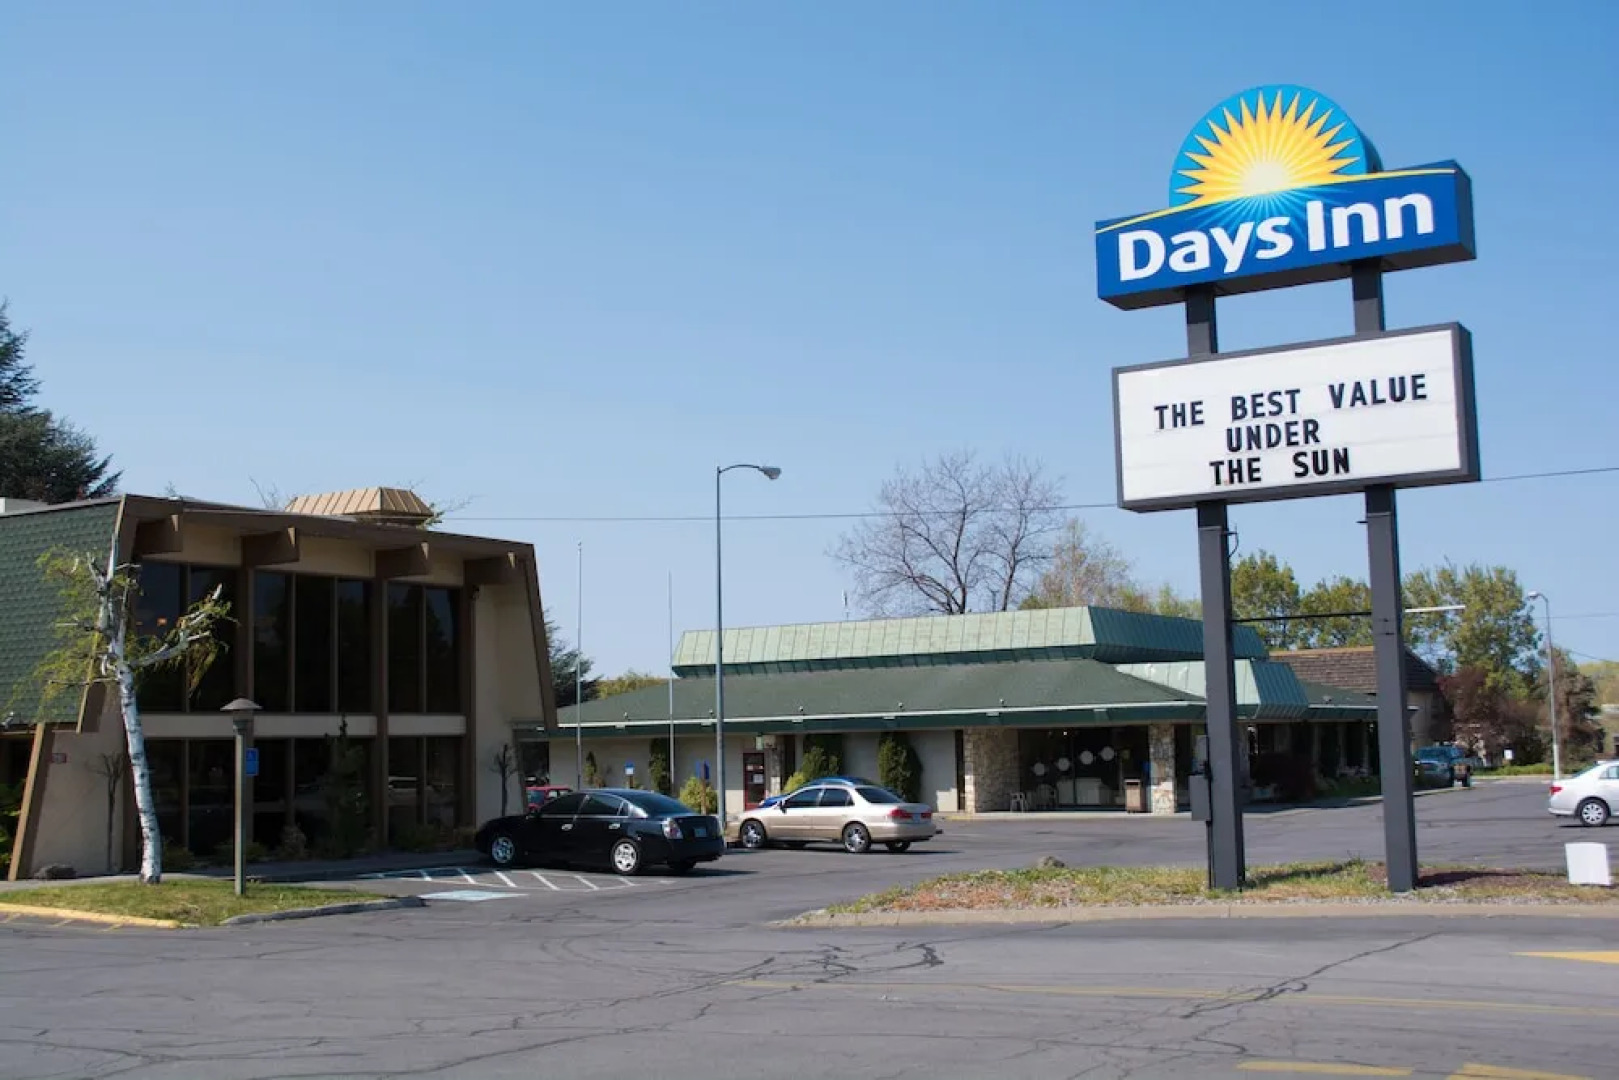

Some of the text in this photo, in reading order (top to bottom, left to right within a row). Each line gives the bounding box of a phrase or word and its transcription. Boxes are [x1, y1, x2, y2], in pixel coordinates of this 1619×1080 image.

[1118, 191, 1435, 283] Days Inn
[1154, 373, 1428, 430] THE BEST VALUE
[1226, 418, 1321, 452] UNDER
[1209, 447, 1351, 486] THE SUN
